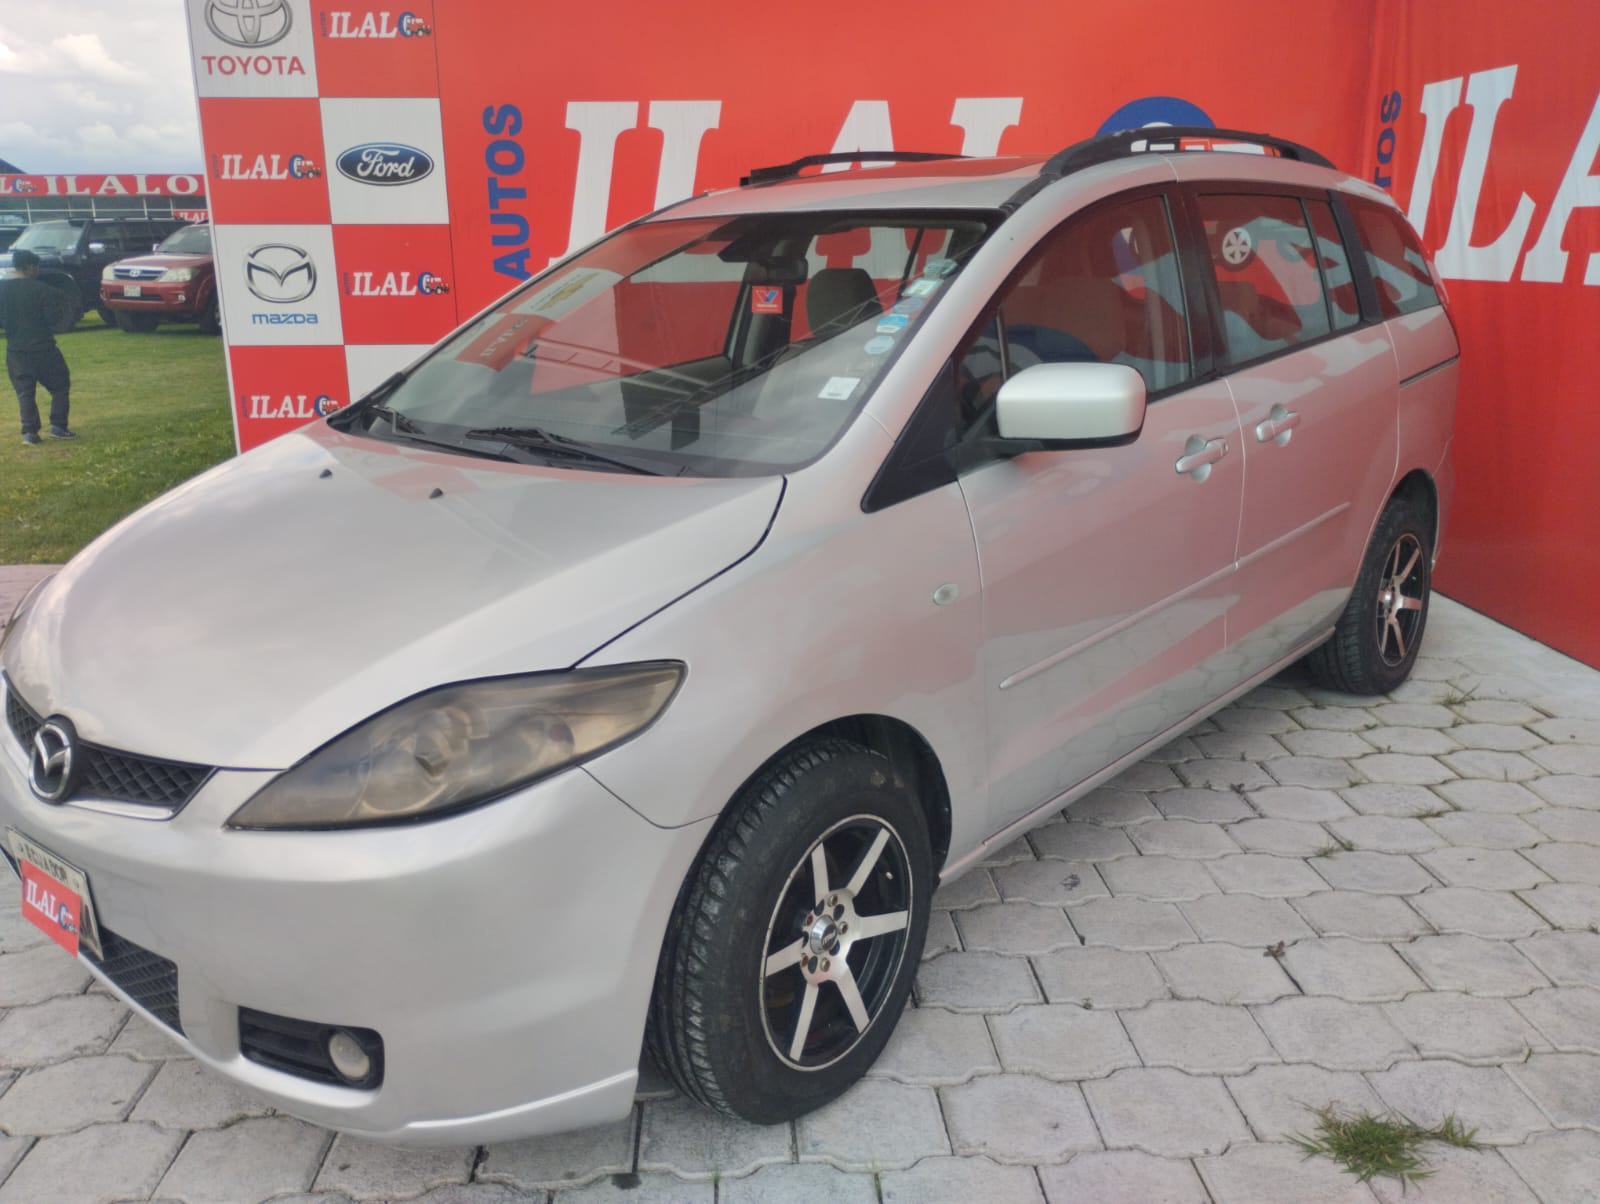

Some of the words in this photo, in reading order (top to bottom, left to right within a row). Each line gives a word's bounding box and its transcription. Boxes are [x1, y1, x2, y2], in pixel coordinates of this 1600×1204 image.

[201, 55, 305, 76] TOYOTA
[356, 148, 415, 178] Ford
[43, 175, 199, 195] ILALO
[482, 103, 532, 280] AUTOS
[252, 313, 319, 325] mazda
